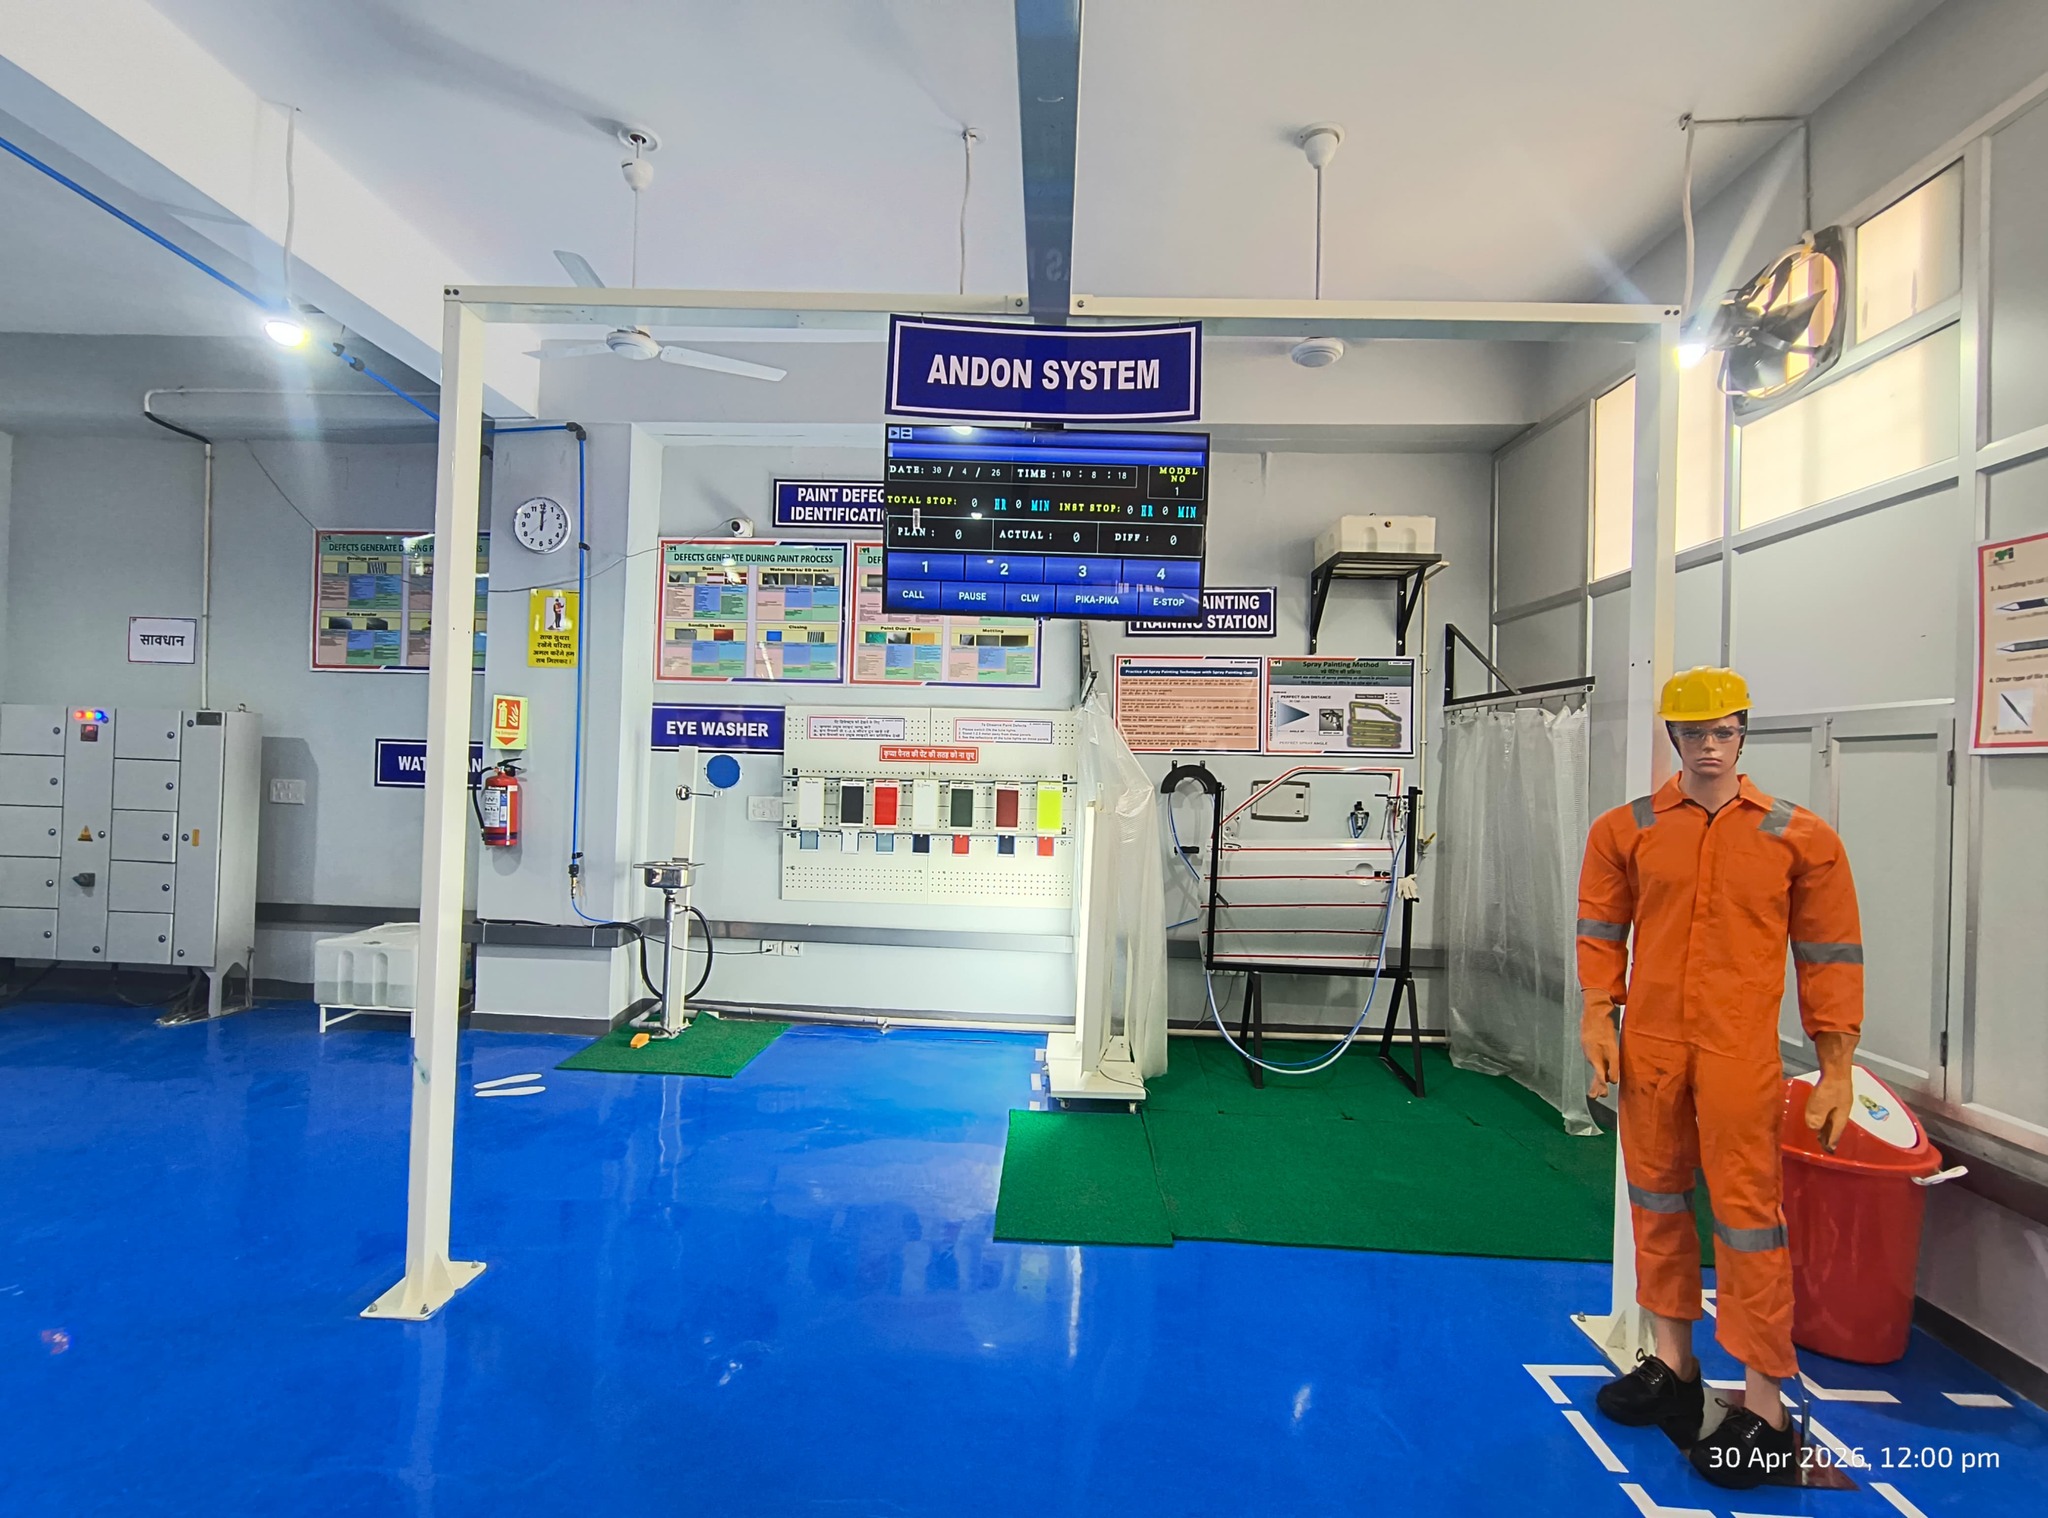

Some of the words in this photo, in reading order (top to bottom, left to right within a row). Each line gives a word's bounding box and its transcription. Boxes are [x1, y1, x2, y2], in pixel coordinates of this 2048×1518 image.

[927, 354, 1032, 389] ANDON
[1042, 359, 1160, 390] SYSTEM
[890, 465, 924, 474] DATE:
[991, 468, 1001, 476] 26
[1018, 469, 1046, 478] TIME
[1159, 467, 1198, 475] MODEL
[798, 488, 838, 502] PAINT
[1175, 487, 1179, 496] 1
[927, 497, 957, 505] STOP:
[972, 498, 978, 507] 0
[994, 498, 1006, 510] HR
[1016, 499, 1022, 508] 0
[1031, 500, 1050, 512] MIN
[1059, 503, 1084, 512] INST
[1090, 504, 1121, 512] STOP:
[1128, 505, 1133, 514] 0
[1141, 505, 1153, 517] HR
[1163, 506, 1168, 515] 0
[1178, 506, 1196, 518] MIN
[791, 507, 884, 522] IDENTIFICATI
[898, 527, 926, 536] PLAN
[955, 529, 962, 539] 0
[1000, 530, 1043, 539] ACTUAL
[1073, 532, 1080, 542] 0
[1115, 533, 1140, 541] DIFF
[1170, 535, 1177, 545] 0
[674, 554, 704, 562] DEFECTS
[922, 561, 928, 573] 1
[1000, 563, 1009, 575] 2
[1079, 565, 1087, 577] 3
[1157, 568, 1166, 580] 4
[902, 590, 924, 599] CALL
[958, 592, 986, 601] PAUSE
[1021, 594, 1039, 602] CLW
[1075, 595, 1119, 604] PIKA-PIKA
[1153, 598, 1184, 606] E-STOP
[1207, 615, 1268, 629] STATION
[140, 634, 185, 646] सावधान
[666, 721, 697, 735] EYE
[701, 722, 769, 737] WASHER
